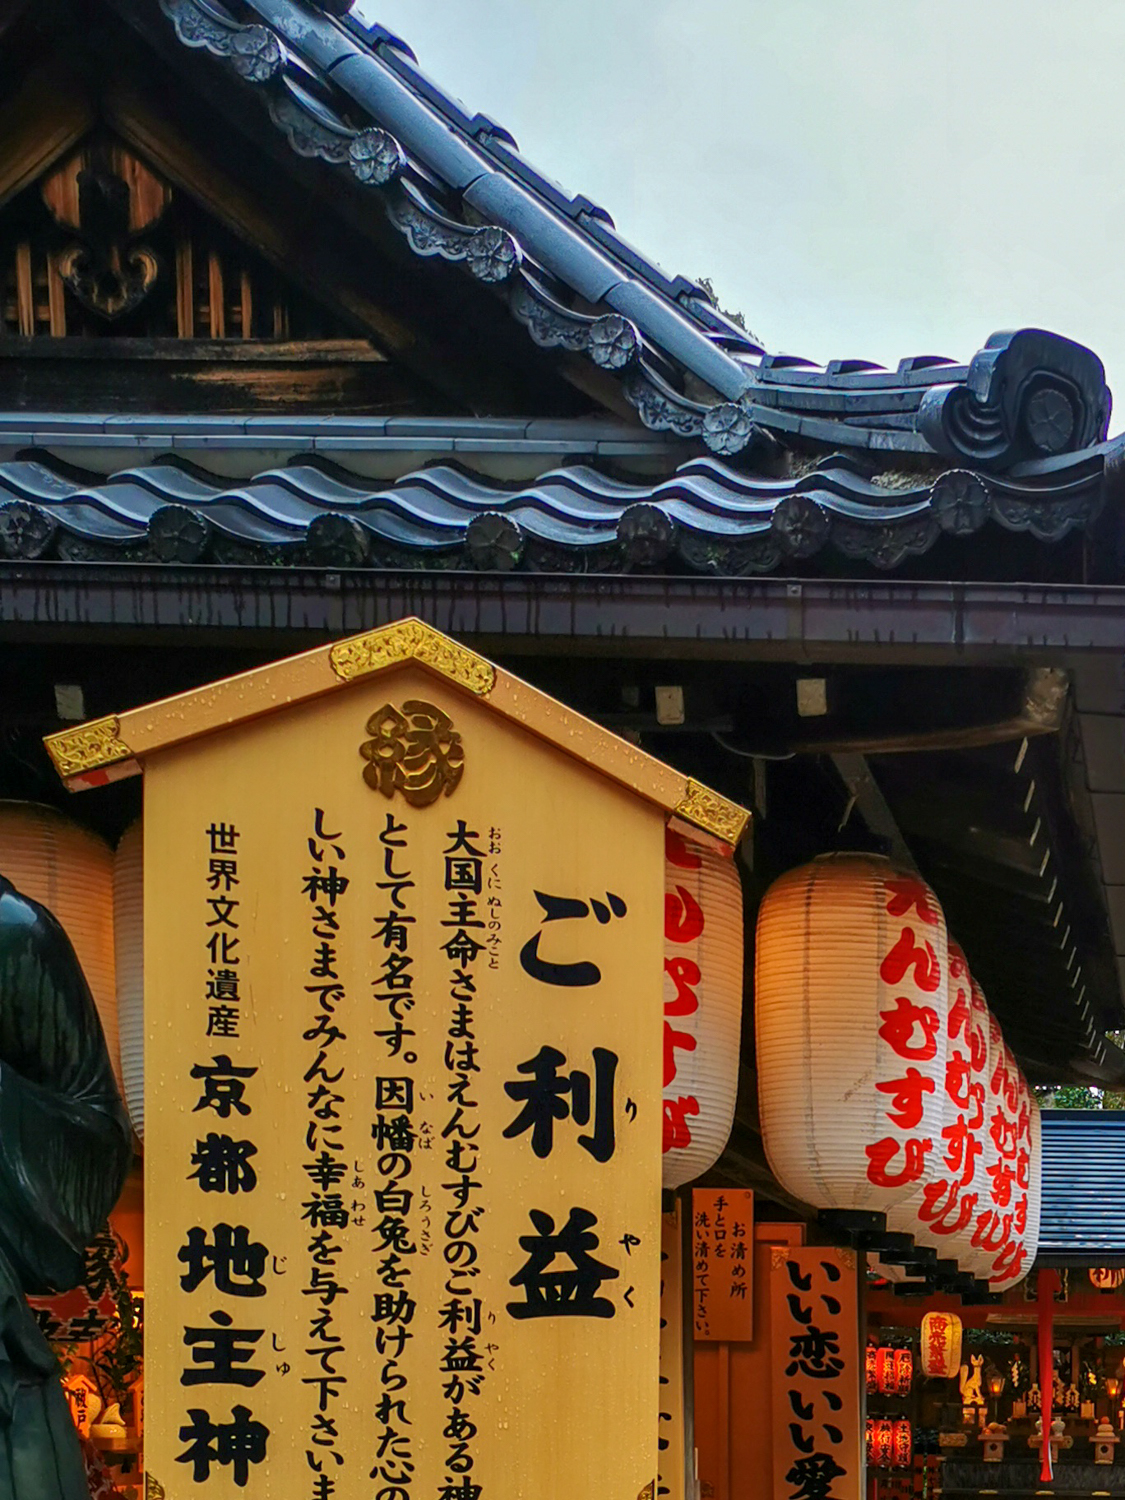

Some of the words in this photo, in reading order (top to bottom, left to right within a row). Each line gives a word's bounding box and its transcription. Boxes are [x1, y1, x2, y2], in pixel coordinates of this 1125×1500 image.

[206, 823, 241, 1039] 世界文化遺産
[502, 889, 628, 1320] ご利益
[866, 877, 941, 1187] えんむすび
[695, 1211, 710, 1336] 洗い清めて下さい。
[713, 1195, 729, 1258] 手と口を
[730, 1221, 748, 1299] お清め所
